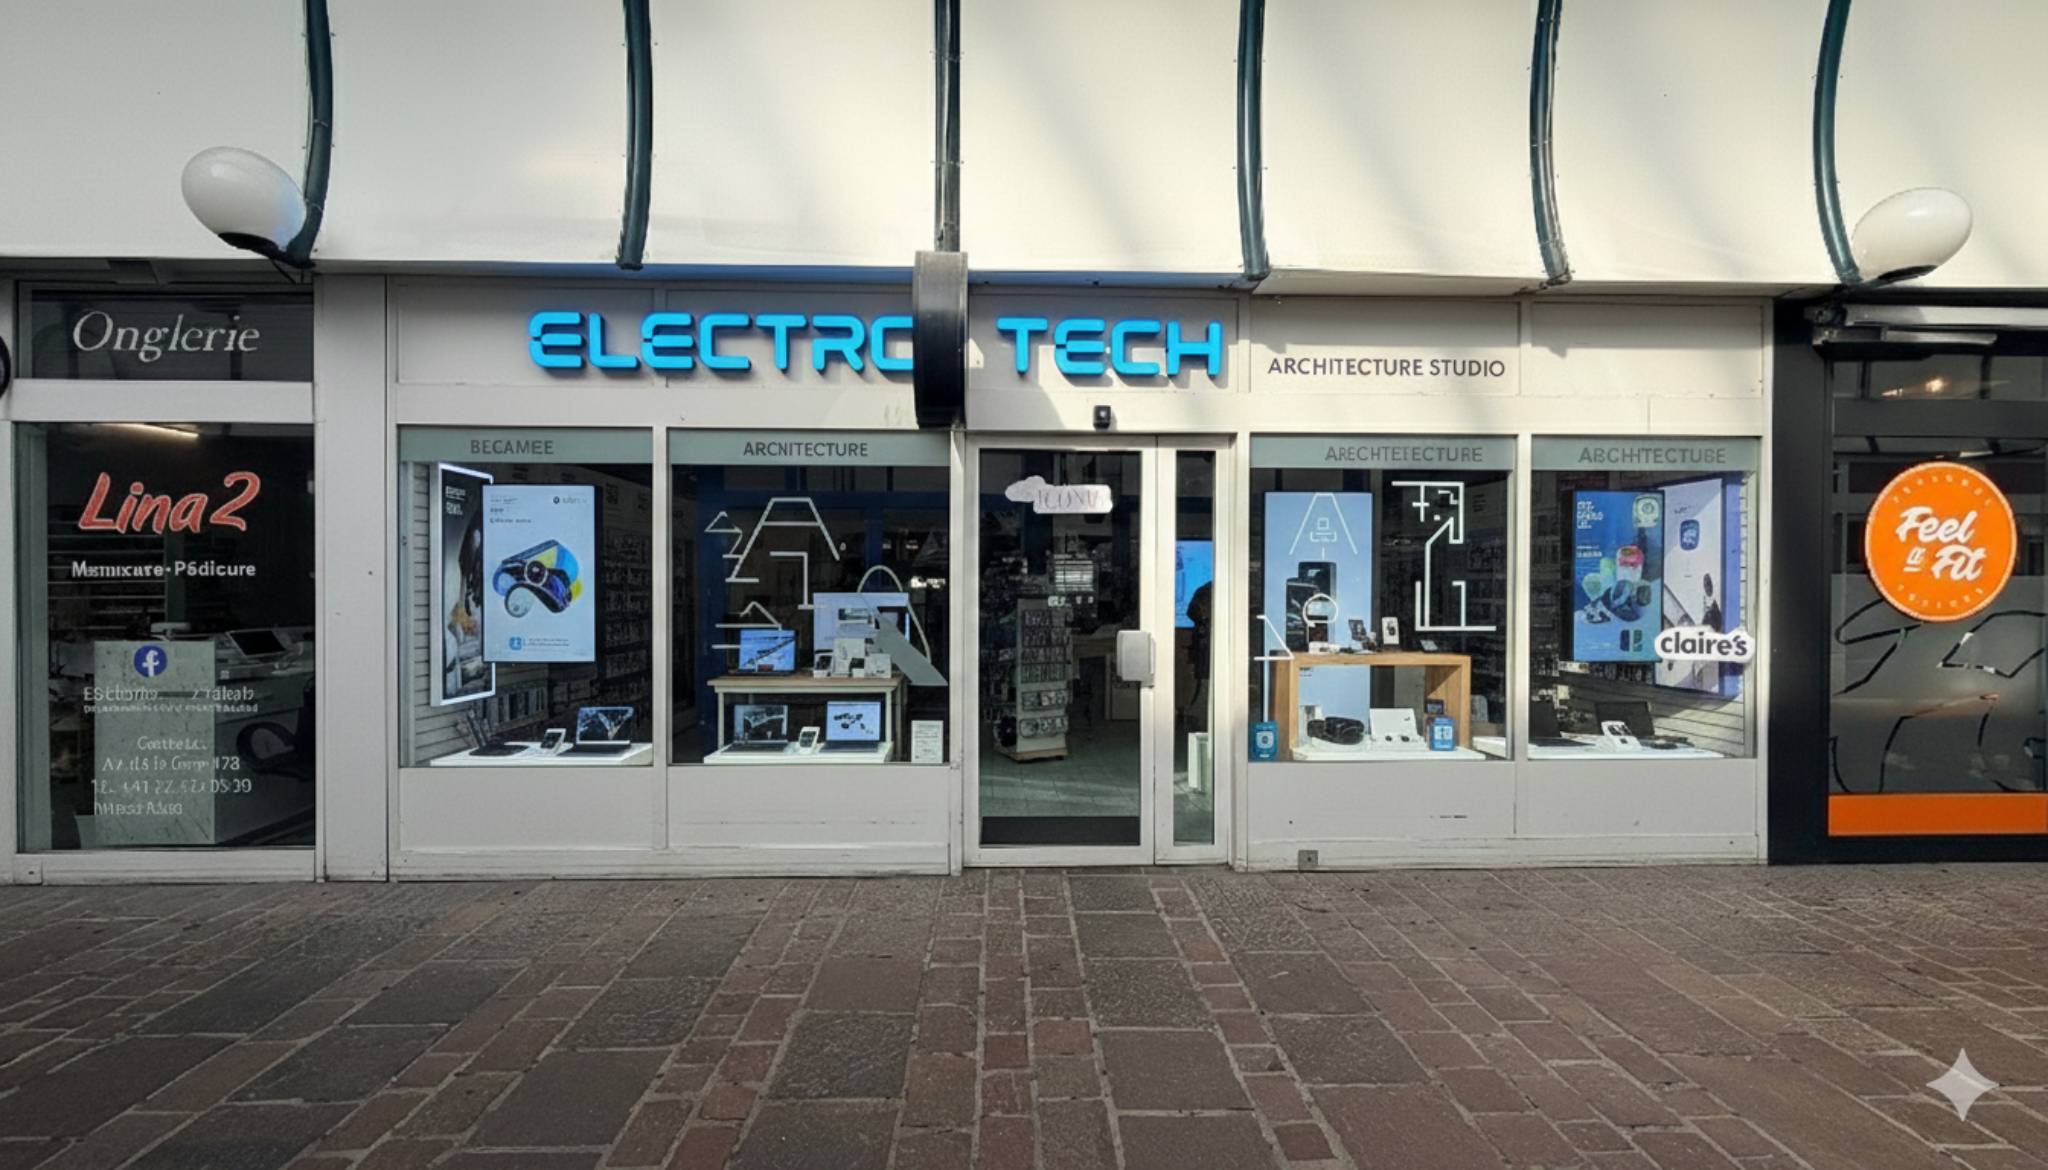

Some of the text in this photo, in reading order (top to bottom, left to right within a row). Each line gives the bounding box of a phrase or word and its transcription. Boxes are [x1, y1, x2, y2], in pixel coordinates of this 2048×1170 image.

[996, 317, 1222, 376] TECH
[1268, 357, 1505, 377] ARCHITECTURE STUDIO
[470, 439, 554, 455] BECAMEE
[1895, 505, 1978, 544] Feel
[1931, 544, 1987, 581] Fit
